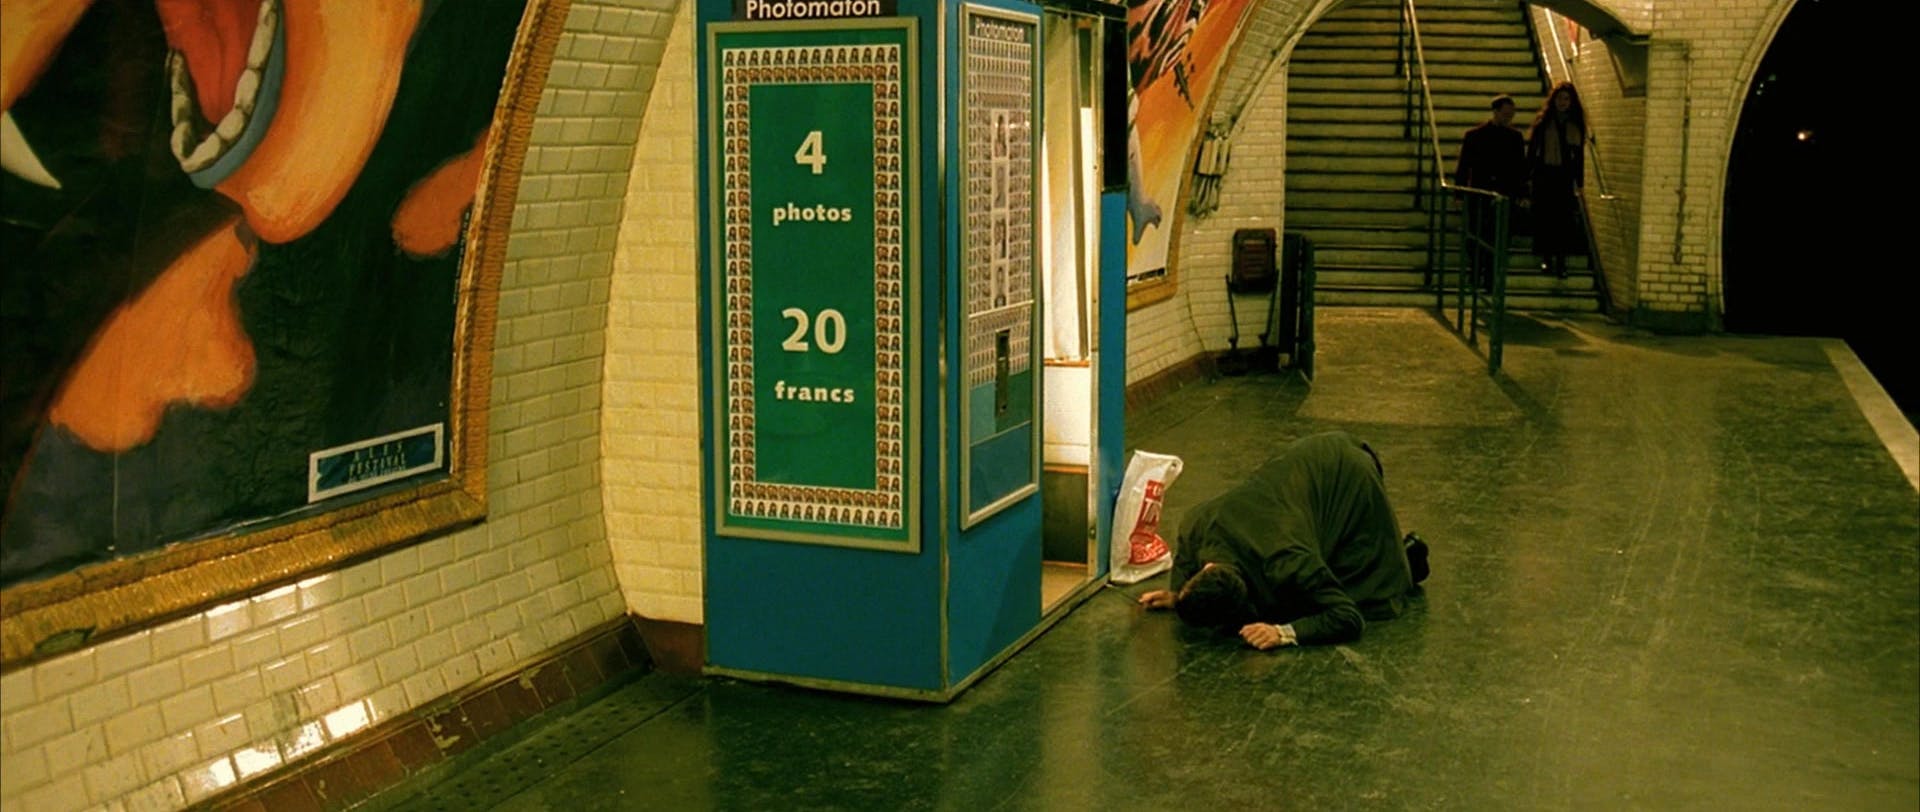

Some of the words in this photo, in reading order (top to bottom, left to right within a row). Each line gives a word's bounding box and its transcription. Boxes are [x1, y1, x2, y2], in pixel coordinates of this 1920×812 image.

[746, 0, 880, 19] Photomaton
[975, 16, 1024, 42] Photomaton
[794, 130, 827, 175] 4
[773, 202, 852, 226] photos
[781, 307, 847, 354] 20
[774, 380, 855, 403] francs
[349, 452, 407, 477] FESTIVAL
